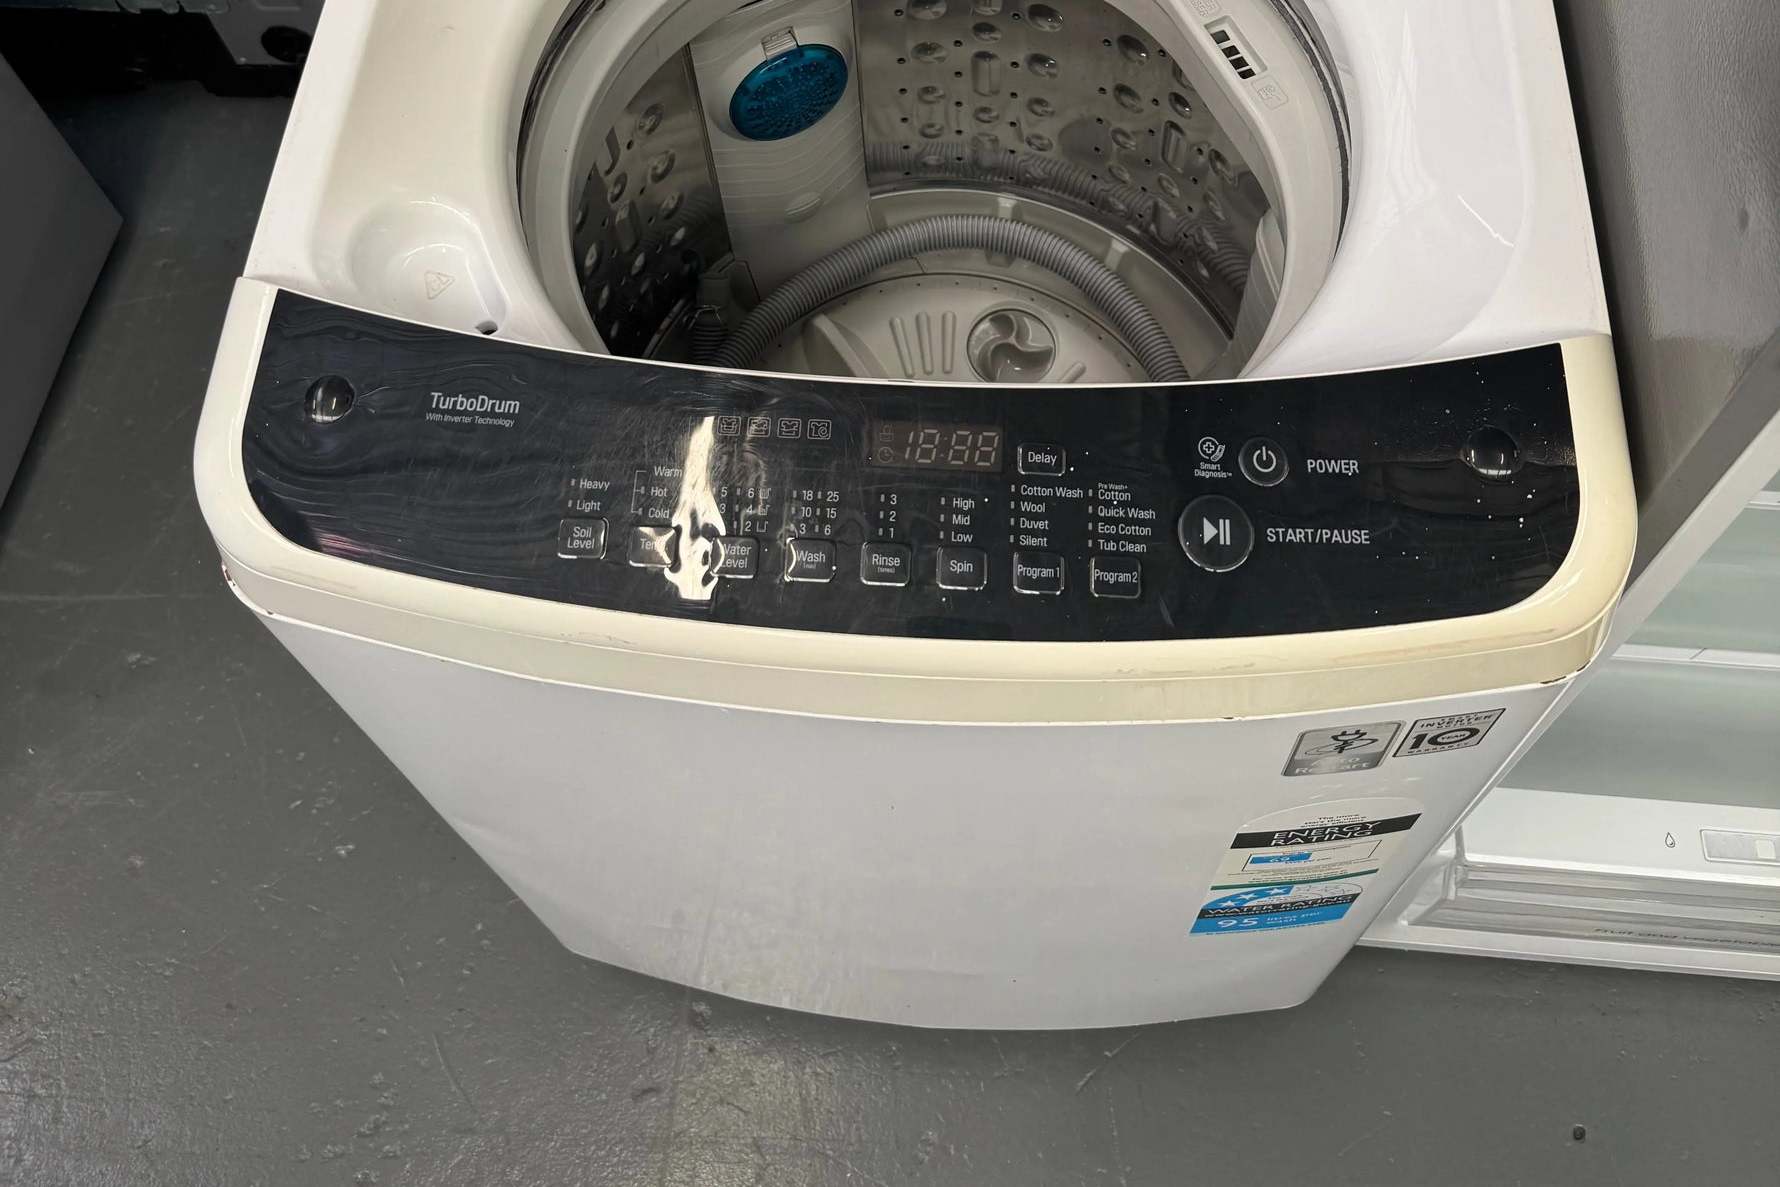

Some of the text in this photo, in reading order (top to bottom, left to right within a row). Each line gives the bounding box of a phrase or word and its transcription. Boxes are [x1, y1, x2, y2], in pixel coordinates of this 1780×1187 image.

[431, 392, 520, 414] TurboDrum
[426, 413, 515, 427] With Inverter Technology
[1028, 451, 1057, 466] Delay
[654, 466, 683, 478] Warm
[1200, 462, 1221, 471] Smart
[1306, 459, 1359, 474] POWER
[580, 478, 611, 491] Heavy
[651, 486, 668, 497] Hot
[720, 486, 728, 497] 5
[747, 487, 755, 498] 6
[802, 490, 814, 501] 18
[826, 491, 840, 502] 25
[1020, 484, 1083, 498] Cotton Wash
[1098, 489, 1131, 501] Cotton
[576, 499, 601, 512] Light
[890, 494, 897, 505] 3
[953, 497, 975, 511] High
[719, 503, 726, 514] 3
[746, 503, 754, 513] 4
[801, 506, 812, 518] 10
[826, 507, 837, 519] 15
[1020, 501, 1046, 513] Wool
[1098, 506, 1156, 519] Quick Wash
[648, 508, 670, 519] Cold
[889, 511, 896, 522] 2
[952, 514, 970, 525] Mid
[744, 521, 752, 531] 2
[800, 523, 807, 534] 3
[824, 524, 831, 535] 6
[1019, 518, 1049, 530] Duvet
[1098, 522, 1152, 536] Eco Cotton
[573, 526, 592, 538] Soil
[889, 528, 894, 538] 1
[951, 531, 973, 542] Low
[1266, 527, 1370, 545] START/PAUSE
[567, 538, 595, 549] Level
[1019, 535, 1048, 547] Silent
[1098, 539, 1147, 553] Tub Clean
[796, 550, 826, 563] Wash
[872, 554, 900, 566] Rinse
[950, 560, 973, 574] Spin
[1017, 565, 1060, 579] Program 1
[1094, 569, 1138, 584] Program 2
[1419, 714, 1493, 728] INVERTER
[1409, 728, 1480, 750] 10
[1441, 733, 1467, 741] YEAR
[1273, 821, 1381, 839] ENERGY
[1270, 830, 1374, 847] RATING
[1280, 895, 1352, 908] RATING
[1208, 903, 1273, 914] WATER
[1217, 917, 1258, 928] 95
